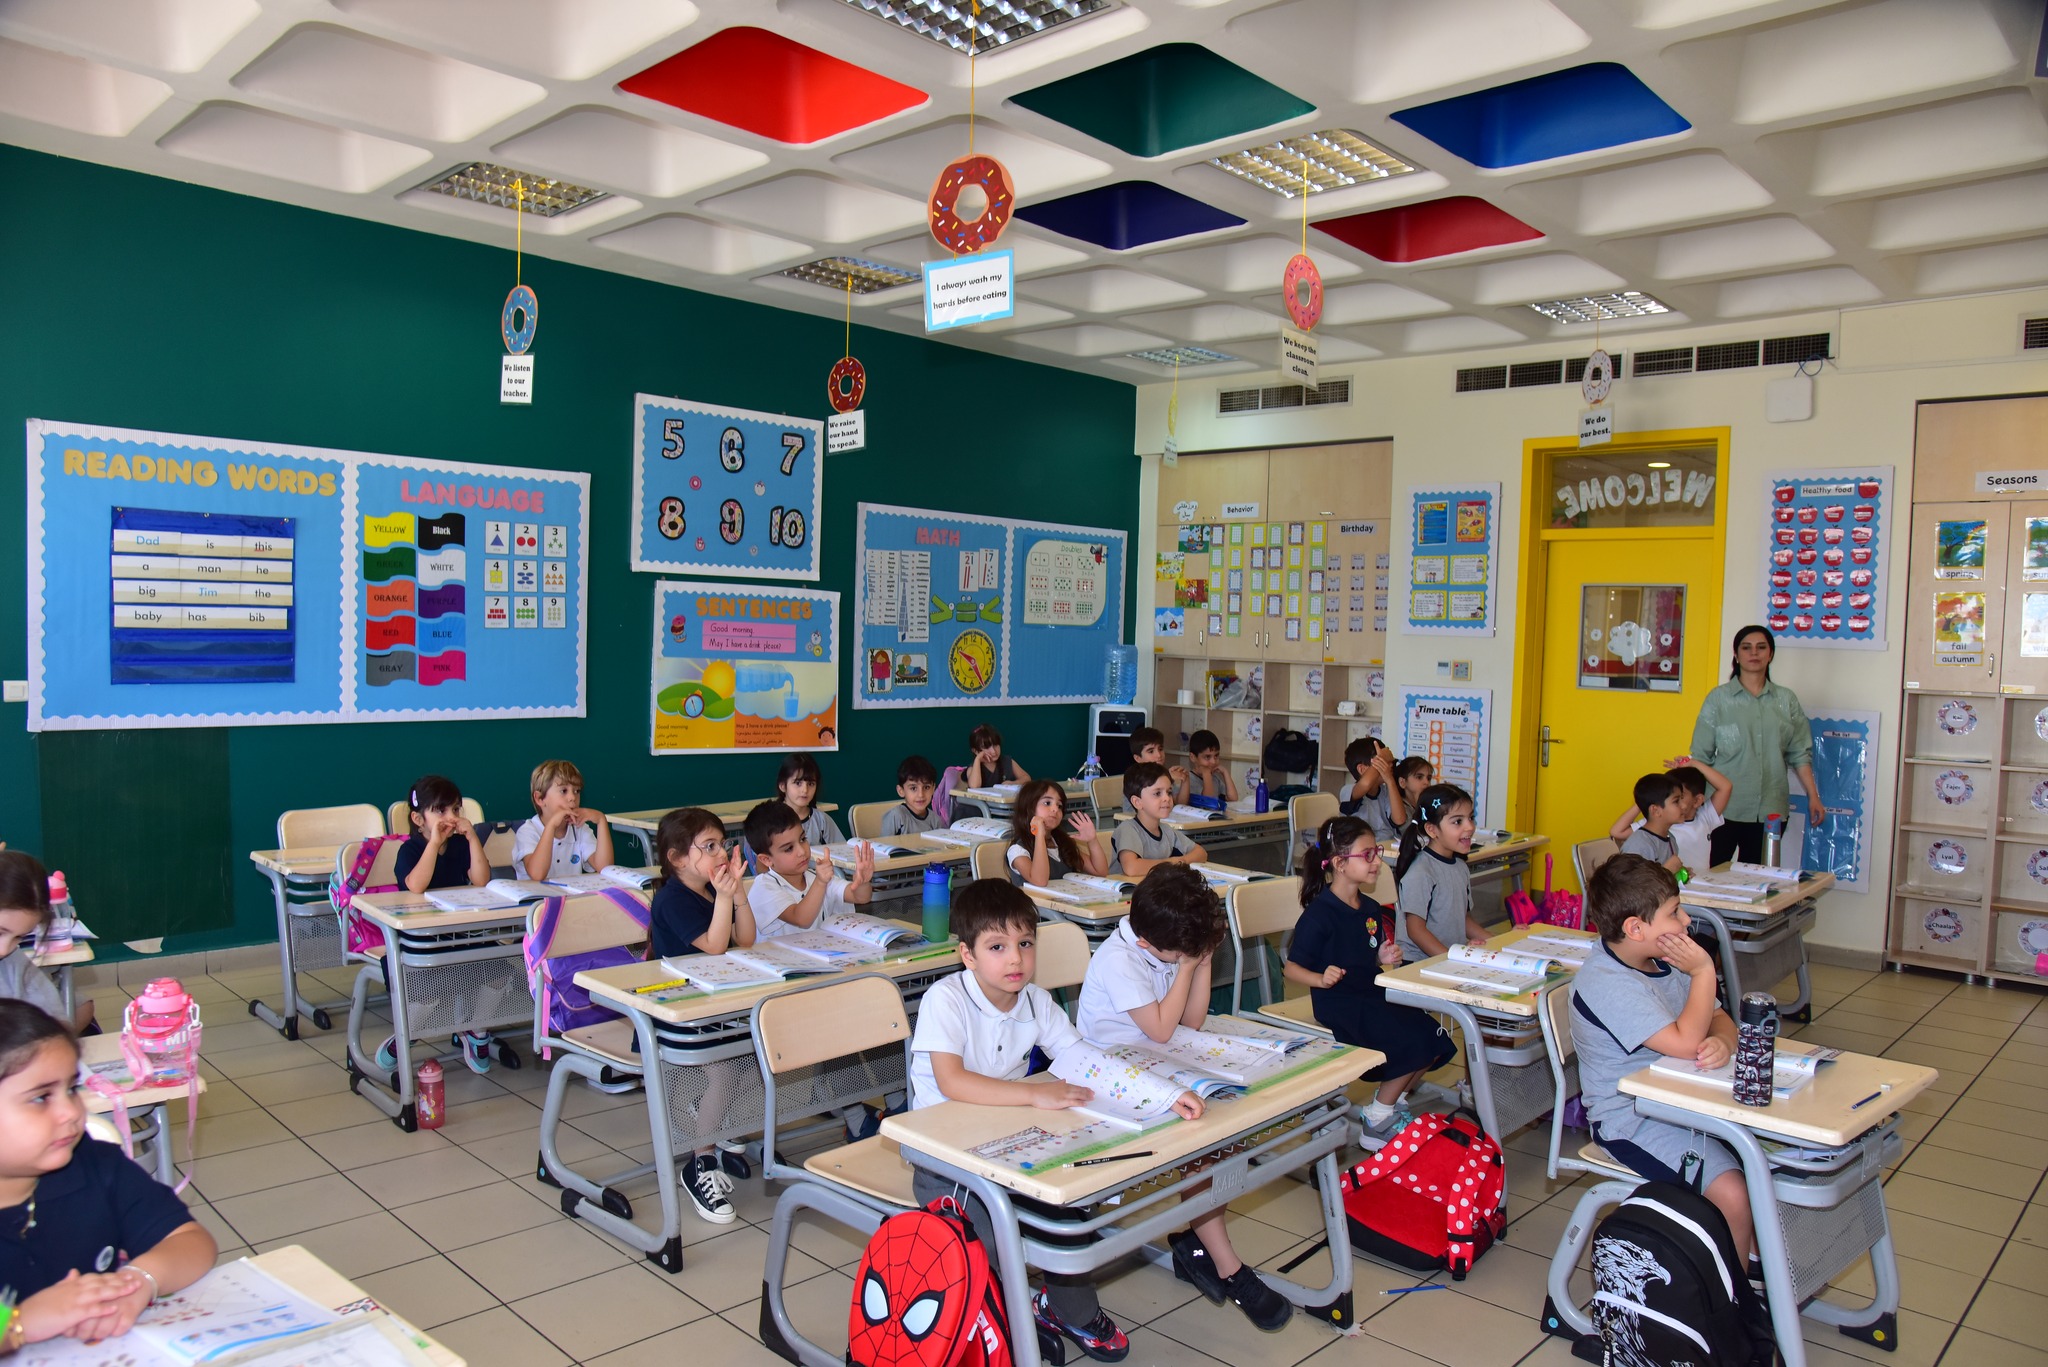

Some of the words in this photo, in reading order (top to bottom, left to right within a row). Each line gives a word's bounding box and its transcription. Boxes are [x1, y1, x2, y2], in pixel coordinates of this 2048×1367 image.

[942, 278, 967, 291] always
[969, 275, 988, 285] wash
[990, 273, 1002, 282] my
[933, 300, 955, 310] hands
[957, 294, 980, 305] before
[982, 290, 1007, 301] eating
[1284, 337, 1293, 346] We
[1294, 340, 1307, 352] keep
[1308, 346, 1316, 355] the
[1286, 351, 1314, 366] classroom
[842, 428, 858, 437] hand
[662, 419, 685, 459] 5
[837, 440, 858, 448] speak.
[720, 427, 744, 472] 6
[781, 433, 805, 476] 7
[63, 449, 218, 487] READING
[228, 463, 336, 496] WORDS
[1987, 475, 2038, 486] Seasons
[400, 480, 544, 514] LANGUAGE
[1227, 505, 1254, 513] Behavior
[658, 496, 686, 540] 8
[720, 499, 744, 544] 9
[374, 525, 406, 534] YELLOW
[433, 525, 450, 535] Black
[524, 526, 529, 534] 2
[770, 505, 806, 548] 10
[1341, 524, 1374, 533] Birthday
[916, 527, 960, 547] MATH
[136, 536, 160, 546] Dad
[206, 540, 214, 549] is
[255, 542, 272, 551] this
[1061, 545, 1082, 553] Doubles
[142, 563, 149, 571] a
[197, 565, 221, 573] man
[256, 565, 269, 574] he
[494, 562, 499, 571] 4
[1946, 570, 1974, 579] spring
[138, 586, 156, 597] big
[198, 588, 217, 597] Jim
[255, 589, 271, 598] the
[427, 597, 456, 605] PURPLE
[494, 598, 499, 606] 7
[551, 598, 556, 606] 9
[696, 597, 812, 620] SENTENCES
[134, 611, 162, 622] baby
[188, 612, 206, 621] has
[249, 613, 265, 622] bib
[711, 623, 728, 632] Good
[709, 639, 723, 649] May
[731, 639, 742, 647] have
[749, 640, 760, 648] drink
[764, 642, 782, 652] please?
[1418, 705, 1440, 715] Time
[1442, 707, 1467, 716] table
[1932, 922, 1956, 930] Chaalan
